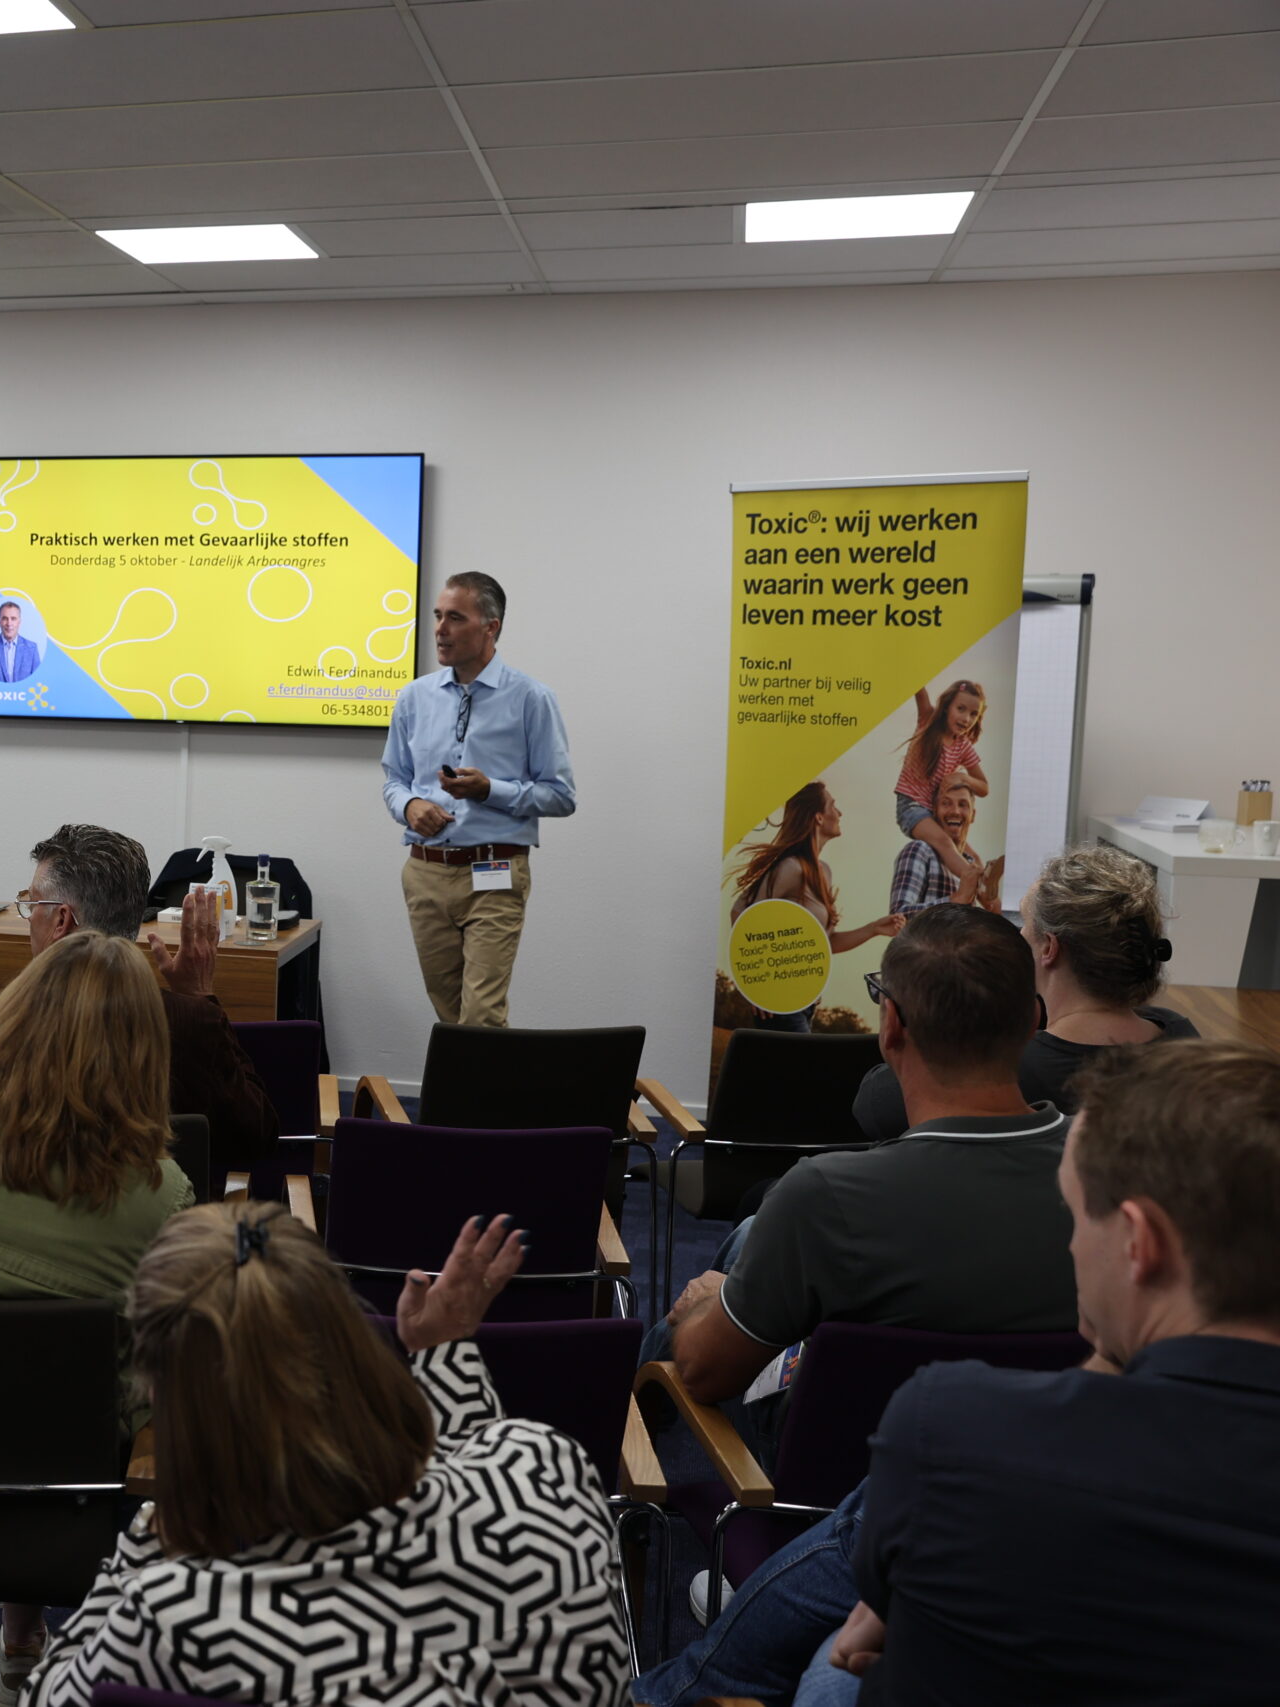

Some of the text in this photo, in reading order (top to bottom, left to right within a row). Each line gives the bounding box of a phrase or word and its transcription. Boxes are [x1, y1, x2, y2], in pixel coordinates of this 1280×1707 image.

[834, 509, 871, 538] wij
[878, 507, 978, 532] werken
[29, 532, 349, 550] Praktisch werken met Gevaarlijke stoffen
[744, 539, 936, 565] aan een wereld
[50, 554, 116, 569] Donderdag
[119, 554, 127, 566] 5
[130, 554, 177, 566] oktober
[189, 555, 244, 570] Landelijk
[246, 555, 326, 570] Arbocongres
[742, 572, 969, 600] waarin werk geen
[741, 603, 943, 627] leven meer kost
[739, 656, 792, 671] Toxic.nl
[286, 665, 408, 679] Edwin Ferdinandus
[267, 683, 401, 699] e.ferdinandus@sdu.n
[738, 674, 872, 695] Uw partner bij veilig
[738, 691, 814, 707] werken met
[321, 703, 393, 717] 06-534801
[737, 710, 858, 727] gevaarlijke stoffen
[744, 927, 804, 942] Vraag naar:
[770, 939, 817, 953] Solutions
[766, 951, 825, 968] Opleidingen
[773, 965, 824, 980] Advisering
